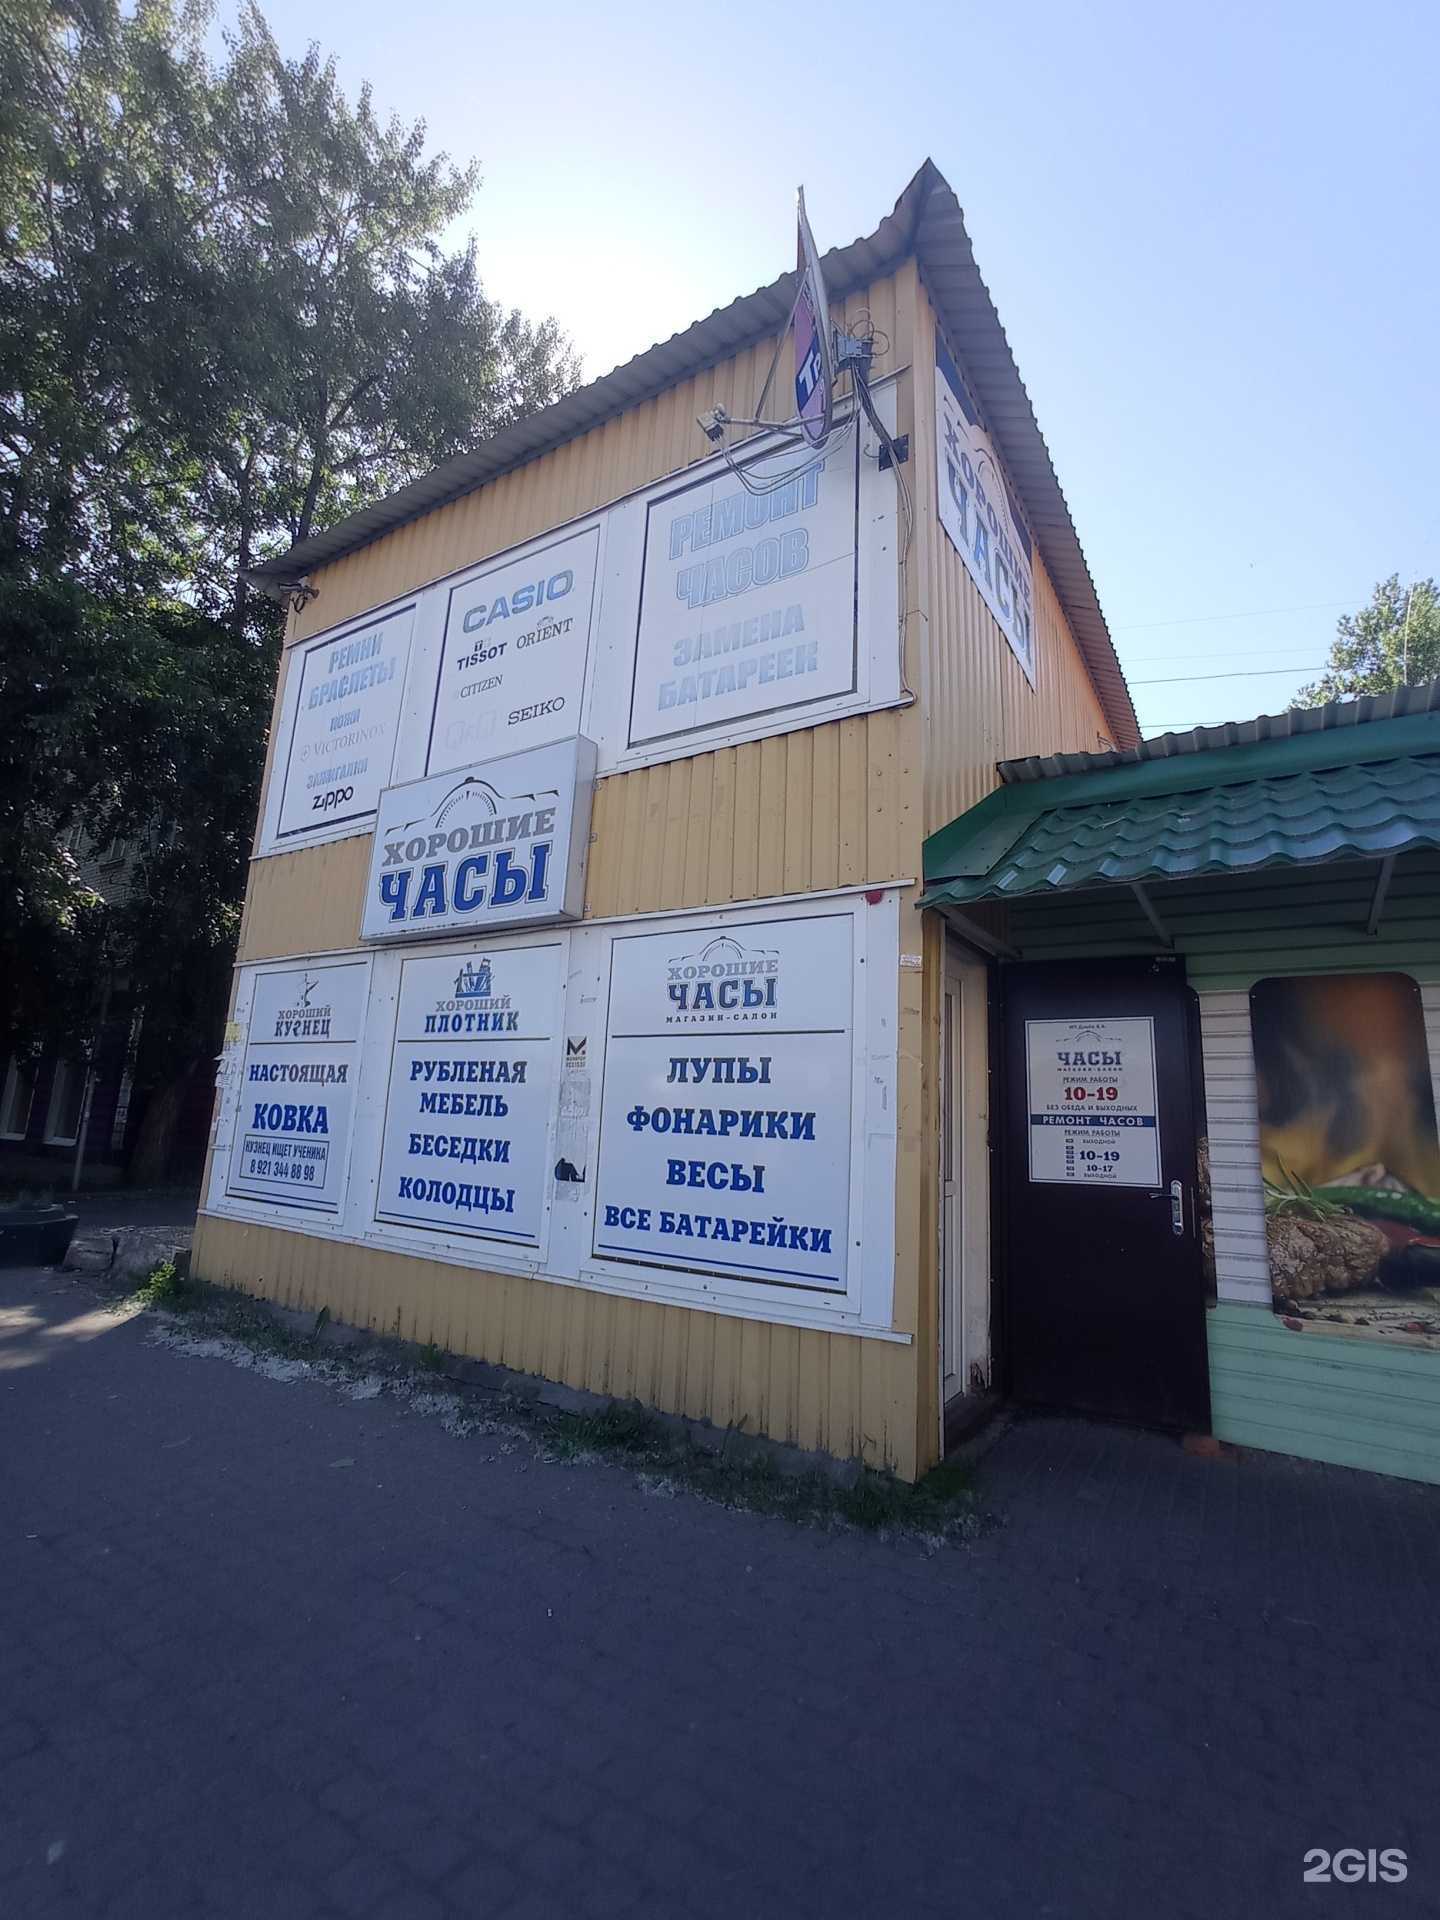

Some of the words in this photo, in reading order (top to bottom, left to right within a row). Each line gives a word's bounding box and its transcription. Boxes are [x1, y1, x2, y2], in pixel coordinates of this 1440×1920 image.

[669, 459, 826, 560] РЕМОНТ
[676, 528, 809, 610] ЧАСОВ
[947, 446, 1032, 666] ЧАСЫ
[463, 569, 574, 633] CASIO
[516, 617, 574, 649] ORIENT
[673, 603, 805, 667] ЗАМЕНА
[457, 642, 508, 671] TISSOT
[308, 657, 397, 710] БРАСЛЕТЫ
[460, 674, 504, 698] CITIZEN
[507, 696, 566, 725] SEIKO
[313, 722, 388, 756] VICTORINOX
[382, 807, 557, 868] ХОРОШИЕ
[377, 840, 554, 923] ЧАСЫ
[667, 959, 779, 980] ХОРОШИЕ
[435, 994, 512, 1013] ХОРОШИЙ
[667, 976, 779, 1012] ЧАСЫ
[277, 1005, 332, 1020] ХОРОШИЙ
[424, 1011, 519, 1033] ПЛОТНИК
[666, 1012, 778, 1023] МАГАЗИН-САЛОН
[410, 1060, 527, 1084] РУБЛЕНАЯ
[667, 1057, 772, 1084] ЛУПЫ
[1057, 1051, 1122, 1066] ЧАСЫ
[249, 1064, 348, 1086] НАСТОЯЩАЯ
[419, 1092, 509, 1118] МЕБЕЛЬ
[1061, 1104, 1086, 1112] ОБЕДА
[1096, 1104, 1138, 1112] ВЫХОДНЫХ
[1064, 1087, 1118, 1101] 10-19
[252, 1103, 329, 1134] КОВКА
[627, 1105, 816, 1141] ФОНАРИКИ
[1042, 1115, 1091, 1125] РЕМОНТ
[1100, 1117, 1144, 1126] ЧАСОВ
[245, 1140, 272, 1158] КУЗНЕЦ
[272, 1143, 293, 1158] ИЩЕТ
[293, 1144, 326, 1161] УЧЕНИКА
[408, 1133, 511, 1165] БЕСЕДКИ
[1080, 1150, 1120, 1161] 10-19
[250, 1159, 257, 1174] 8
[257, 1159, 272, 1176] 921
[273, 1161, 289, 1178] 344
[303, 1165, 315, 1181] 98
[666, 1159, 766, 1193] ВЕСЫ
[1087, 1164, 1113, 1172] 10-17
[398, 1176, 516, 1214] КОЛОДЦЫ
[604, 1205, 651, 1231] ВСЕ
[659, 1211, 832, 1253] БАТАРЕЙКИ
